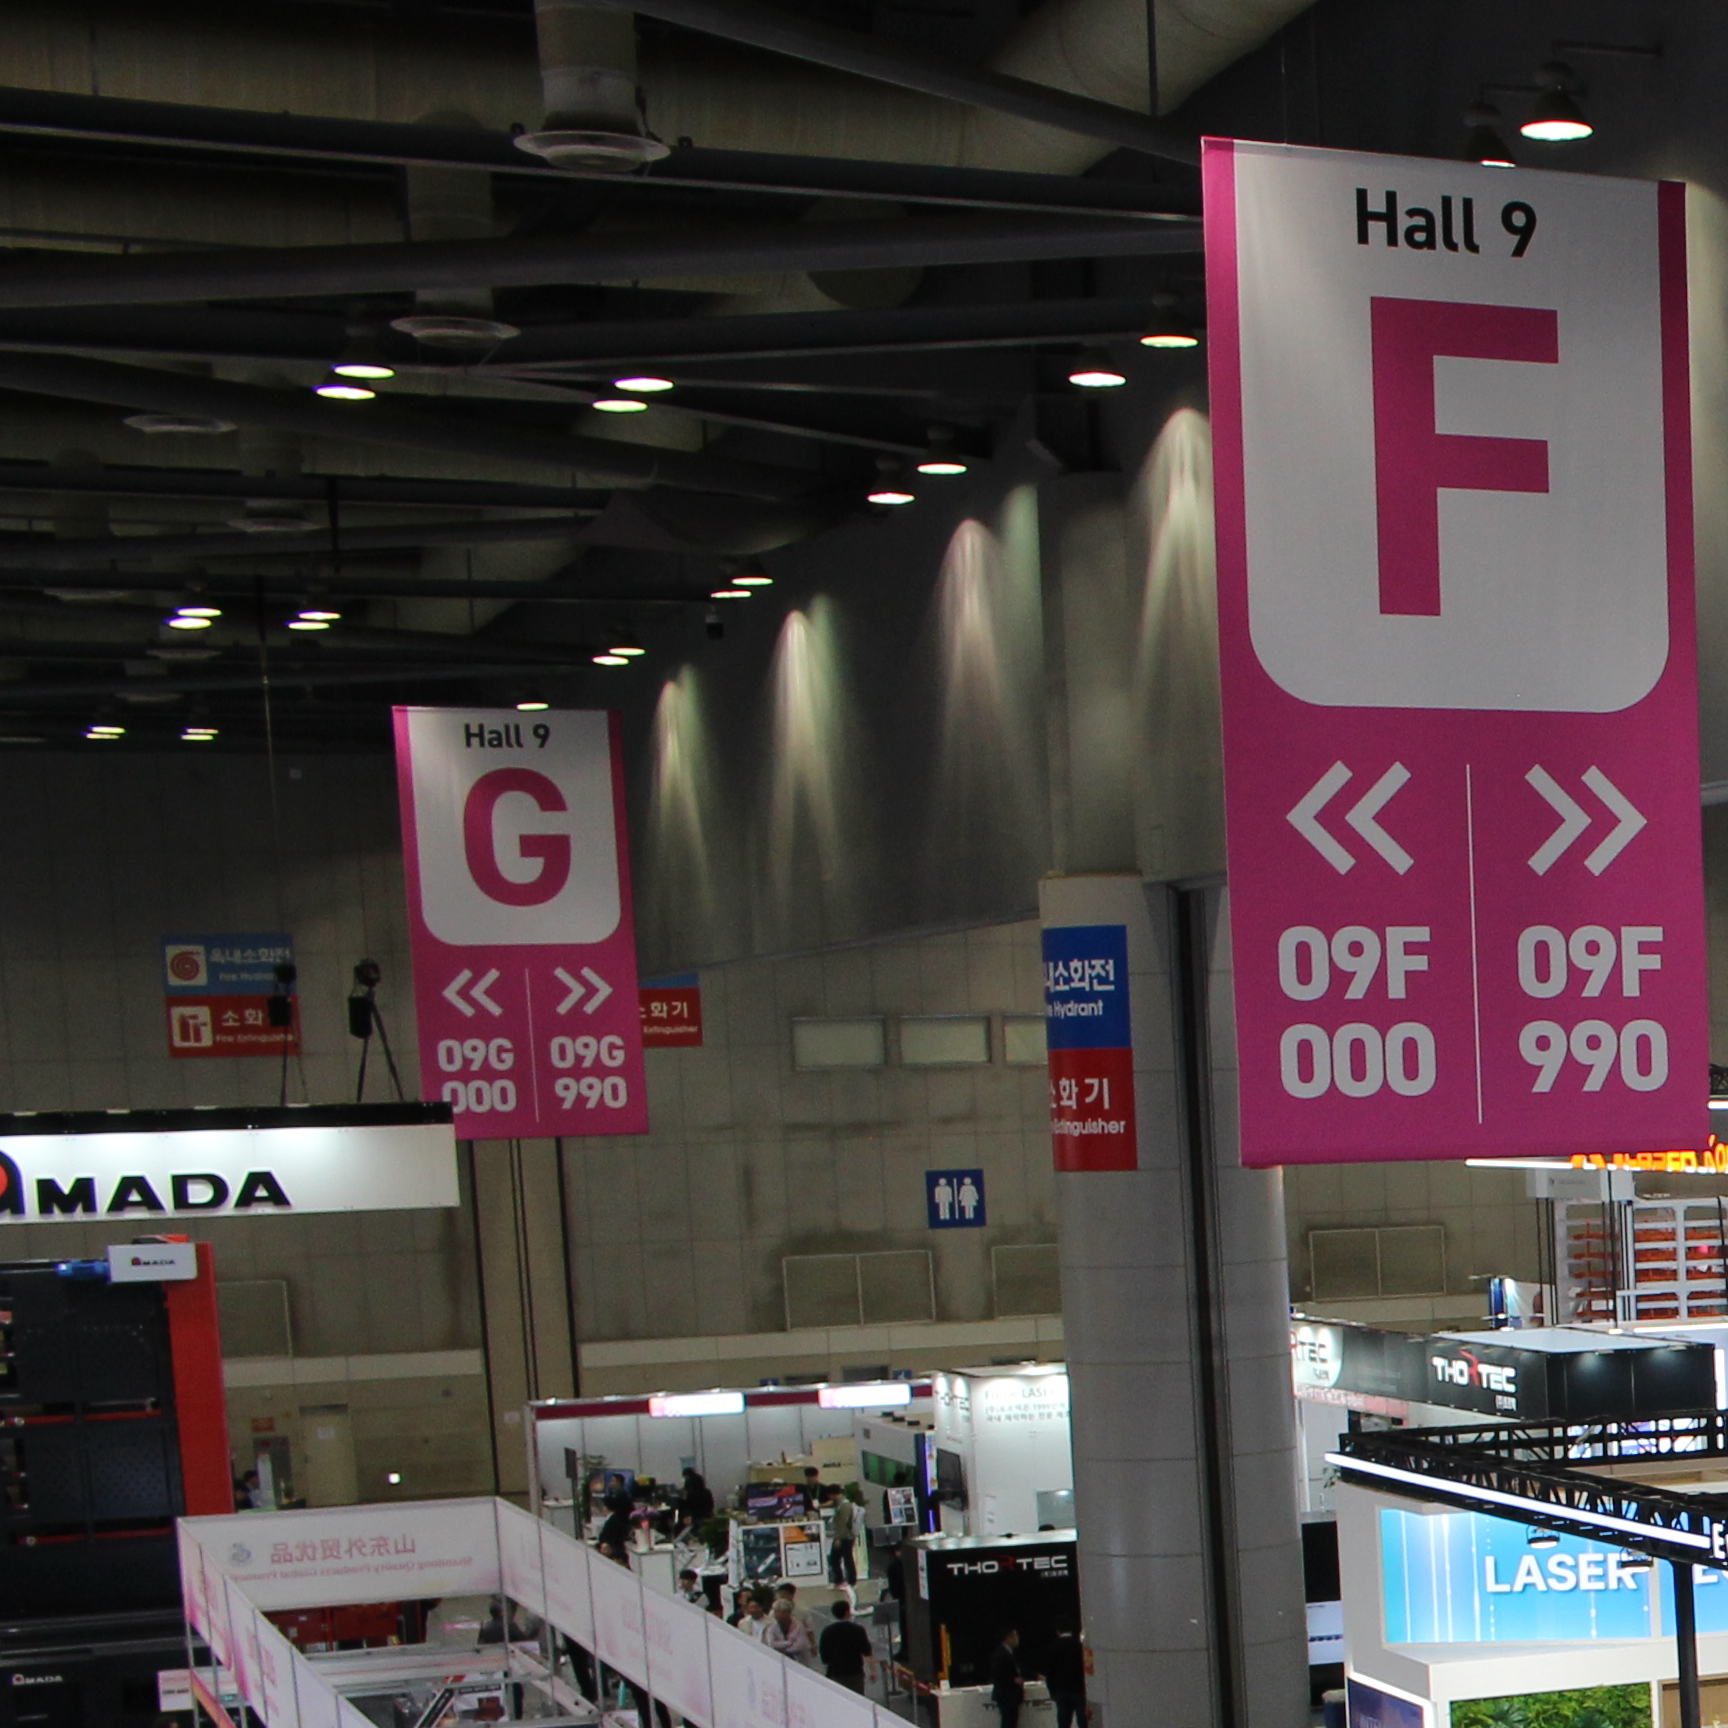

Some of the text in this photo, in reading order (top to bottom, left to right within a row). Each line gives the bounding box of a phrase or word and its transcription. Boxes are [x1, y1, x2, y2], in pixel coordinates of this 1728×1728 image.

[1354, 188, 1539, 257] Hall 9
[1371, 296, 1560, 617] F
[464, 723, 551, 749] Hall 9
[463, 767, 572, 907] G
[1277, 925, 1433, 1000] 09F
[1516, 923, 1665, 999] 09F
[1053, 1000, 1104, 1020] Hydrant
[437, 1038, 515, 1073] 09G
[551, 1035, 626, 1070] 09G
[1280, 1022, 1437, 1099] 000
[1518, 1019, 1670, 1093] 990
[442, 1079, 517, 1115] 000
[554, 1076, 628, 1110] 990
[1431, 1350, 1517, 1393] THORTEC
[946, 1554, 1068, 1577] THORTEC
[1484, 1549, 1640, 1594] LASER
